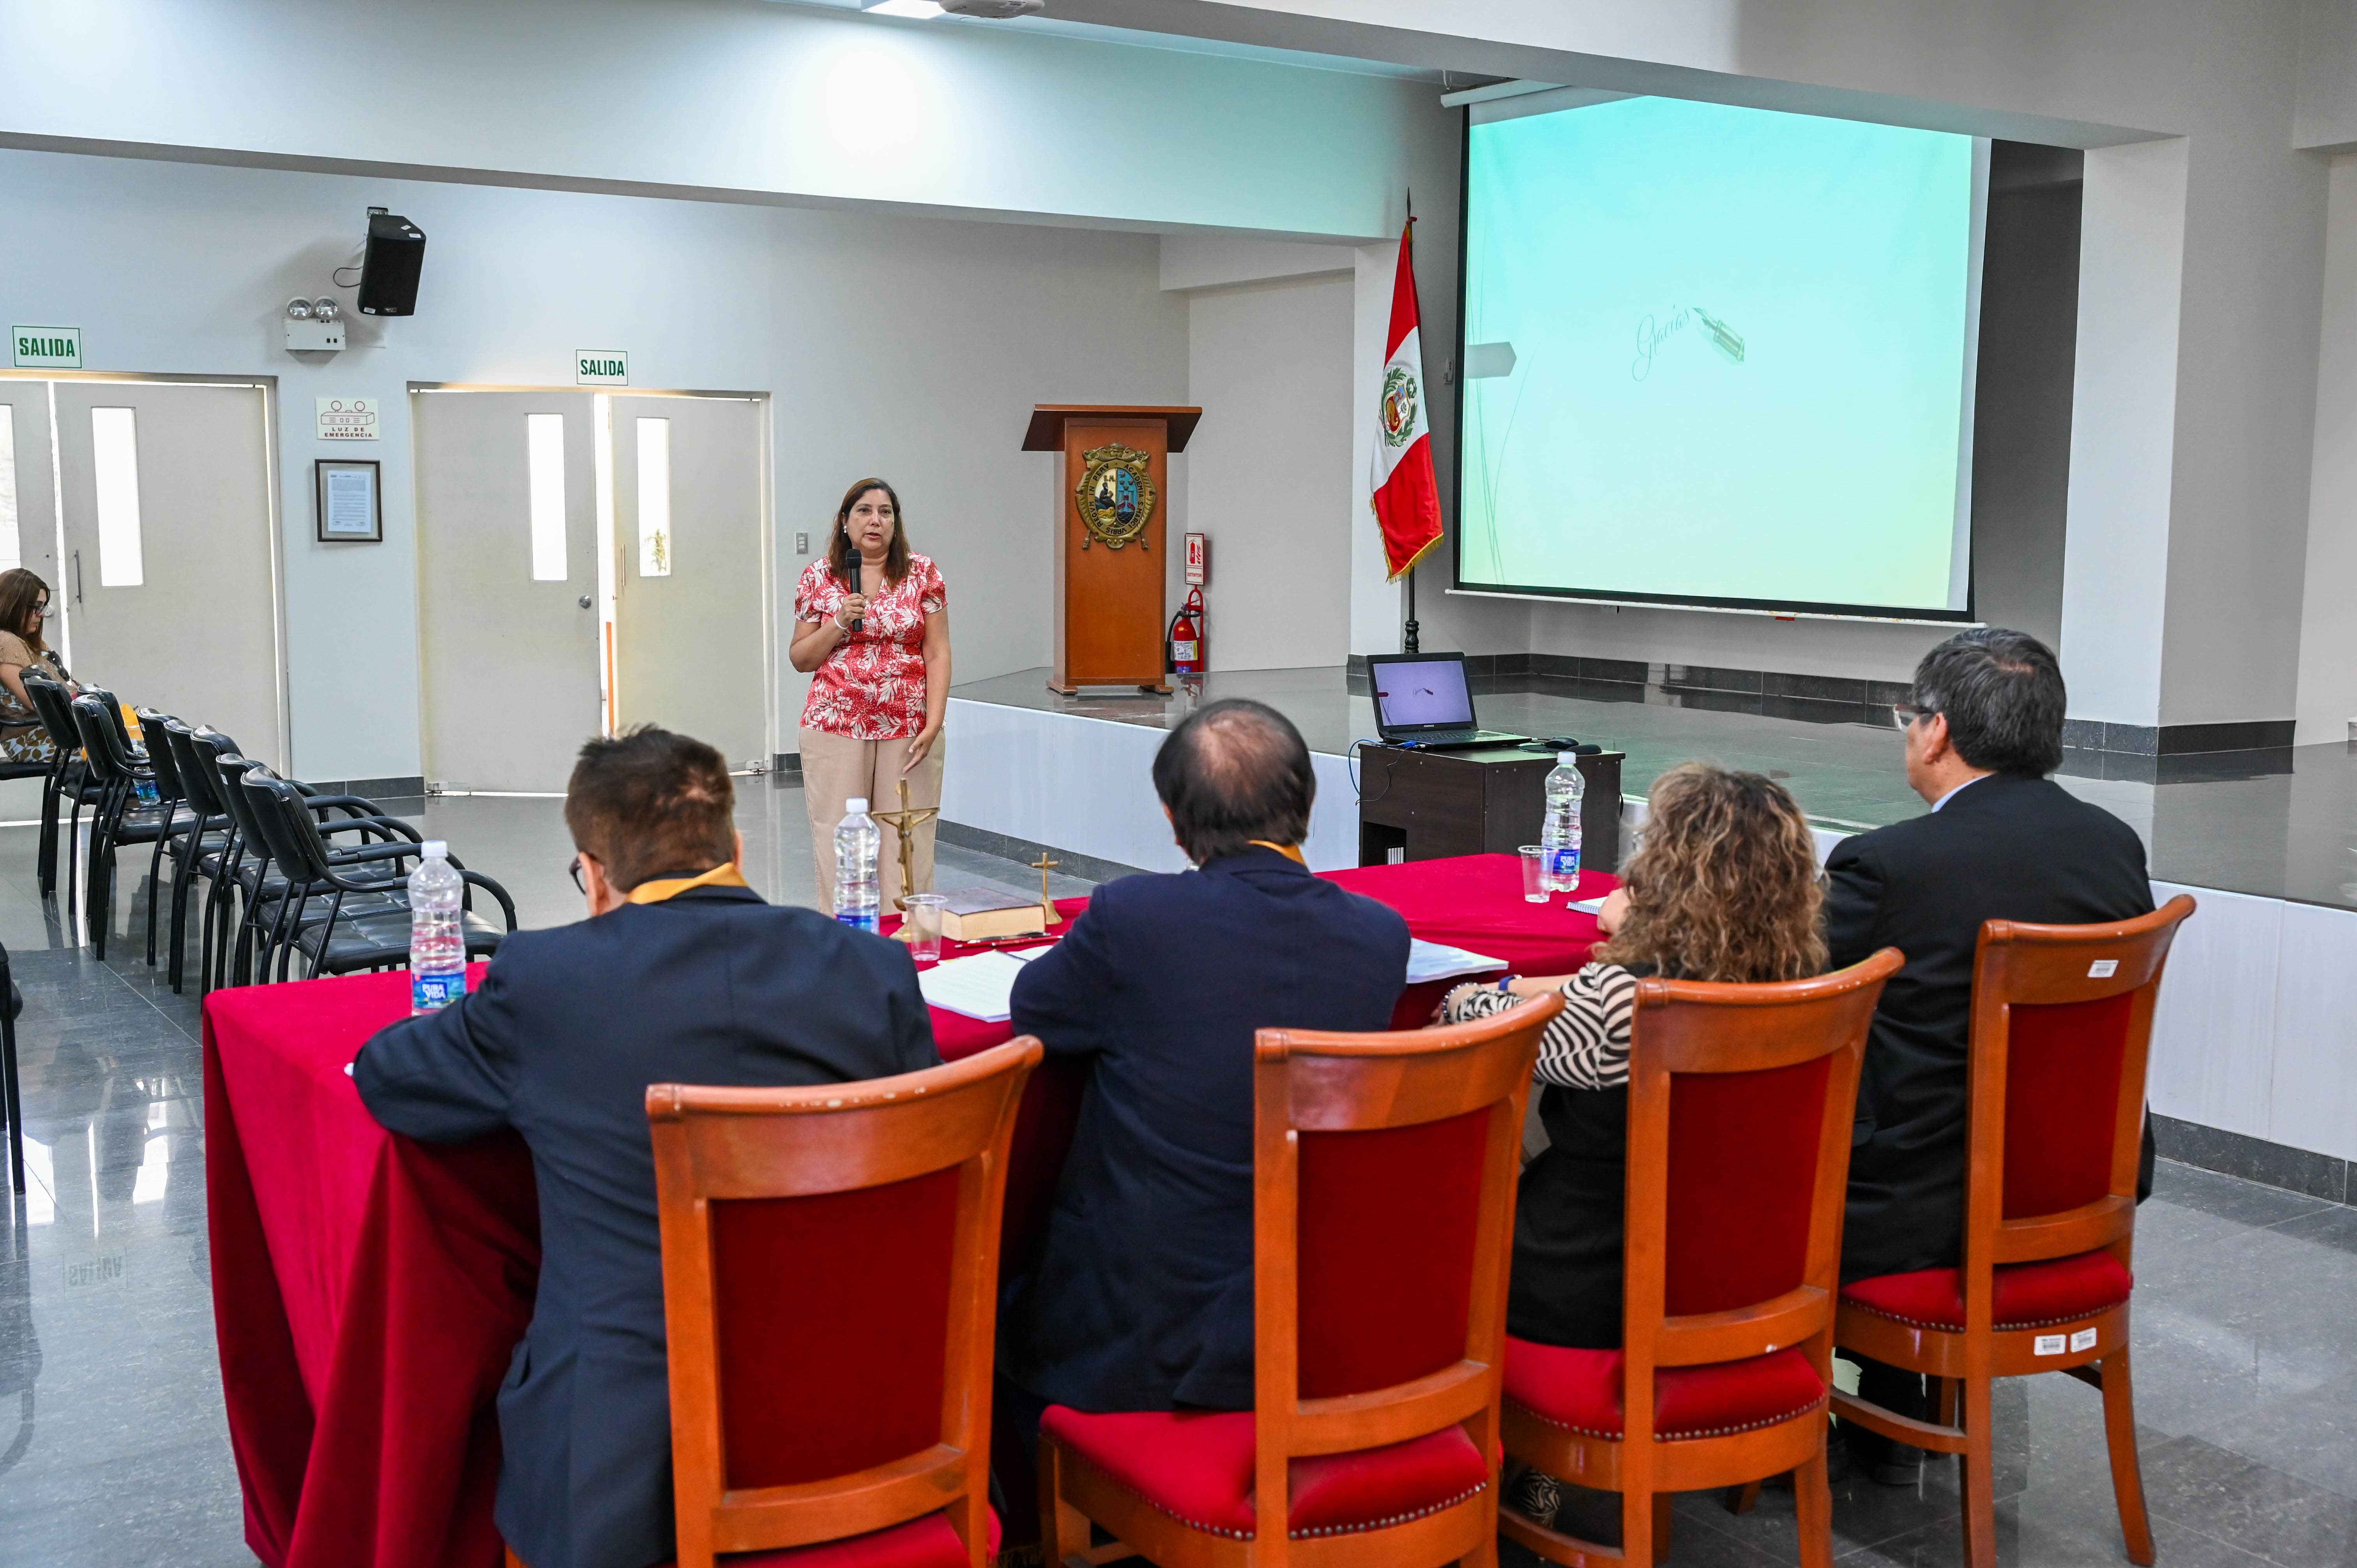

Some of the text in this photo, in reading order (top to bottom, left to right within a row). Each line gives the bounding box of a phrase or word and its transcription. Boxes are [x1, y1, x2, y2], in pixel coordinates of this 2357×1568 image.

[19, 337, 75, 357] SALIDA
[580, 359, 625, 376] SALIDA
[1093, 463, 1109, 481] PERV
[1124, 464, 1144, 498] ACADEMIA
[1089, 486, 1095, 495] IN
[1089, 501, 1103, 527] REGVM
[1106, 527, 1127, 535] VRBIS
[422, 983, 444, 992] PURA
[426, 990, 446, 999] VIDA
